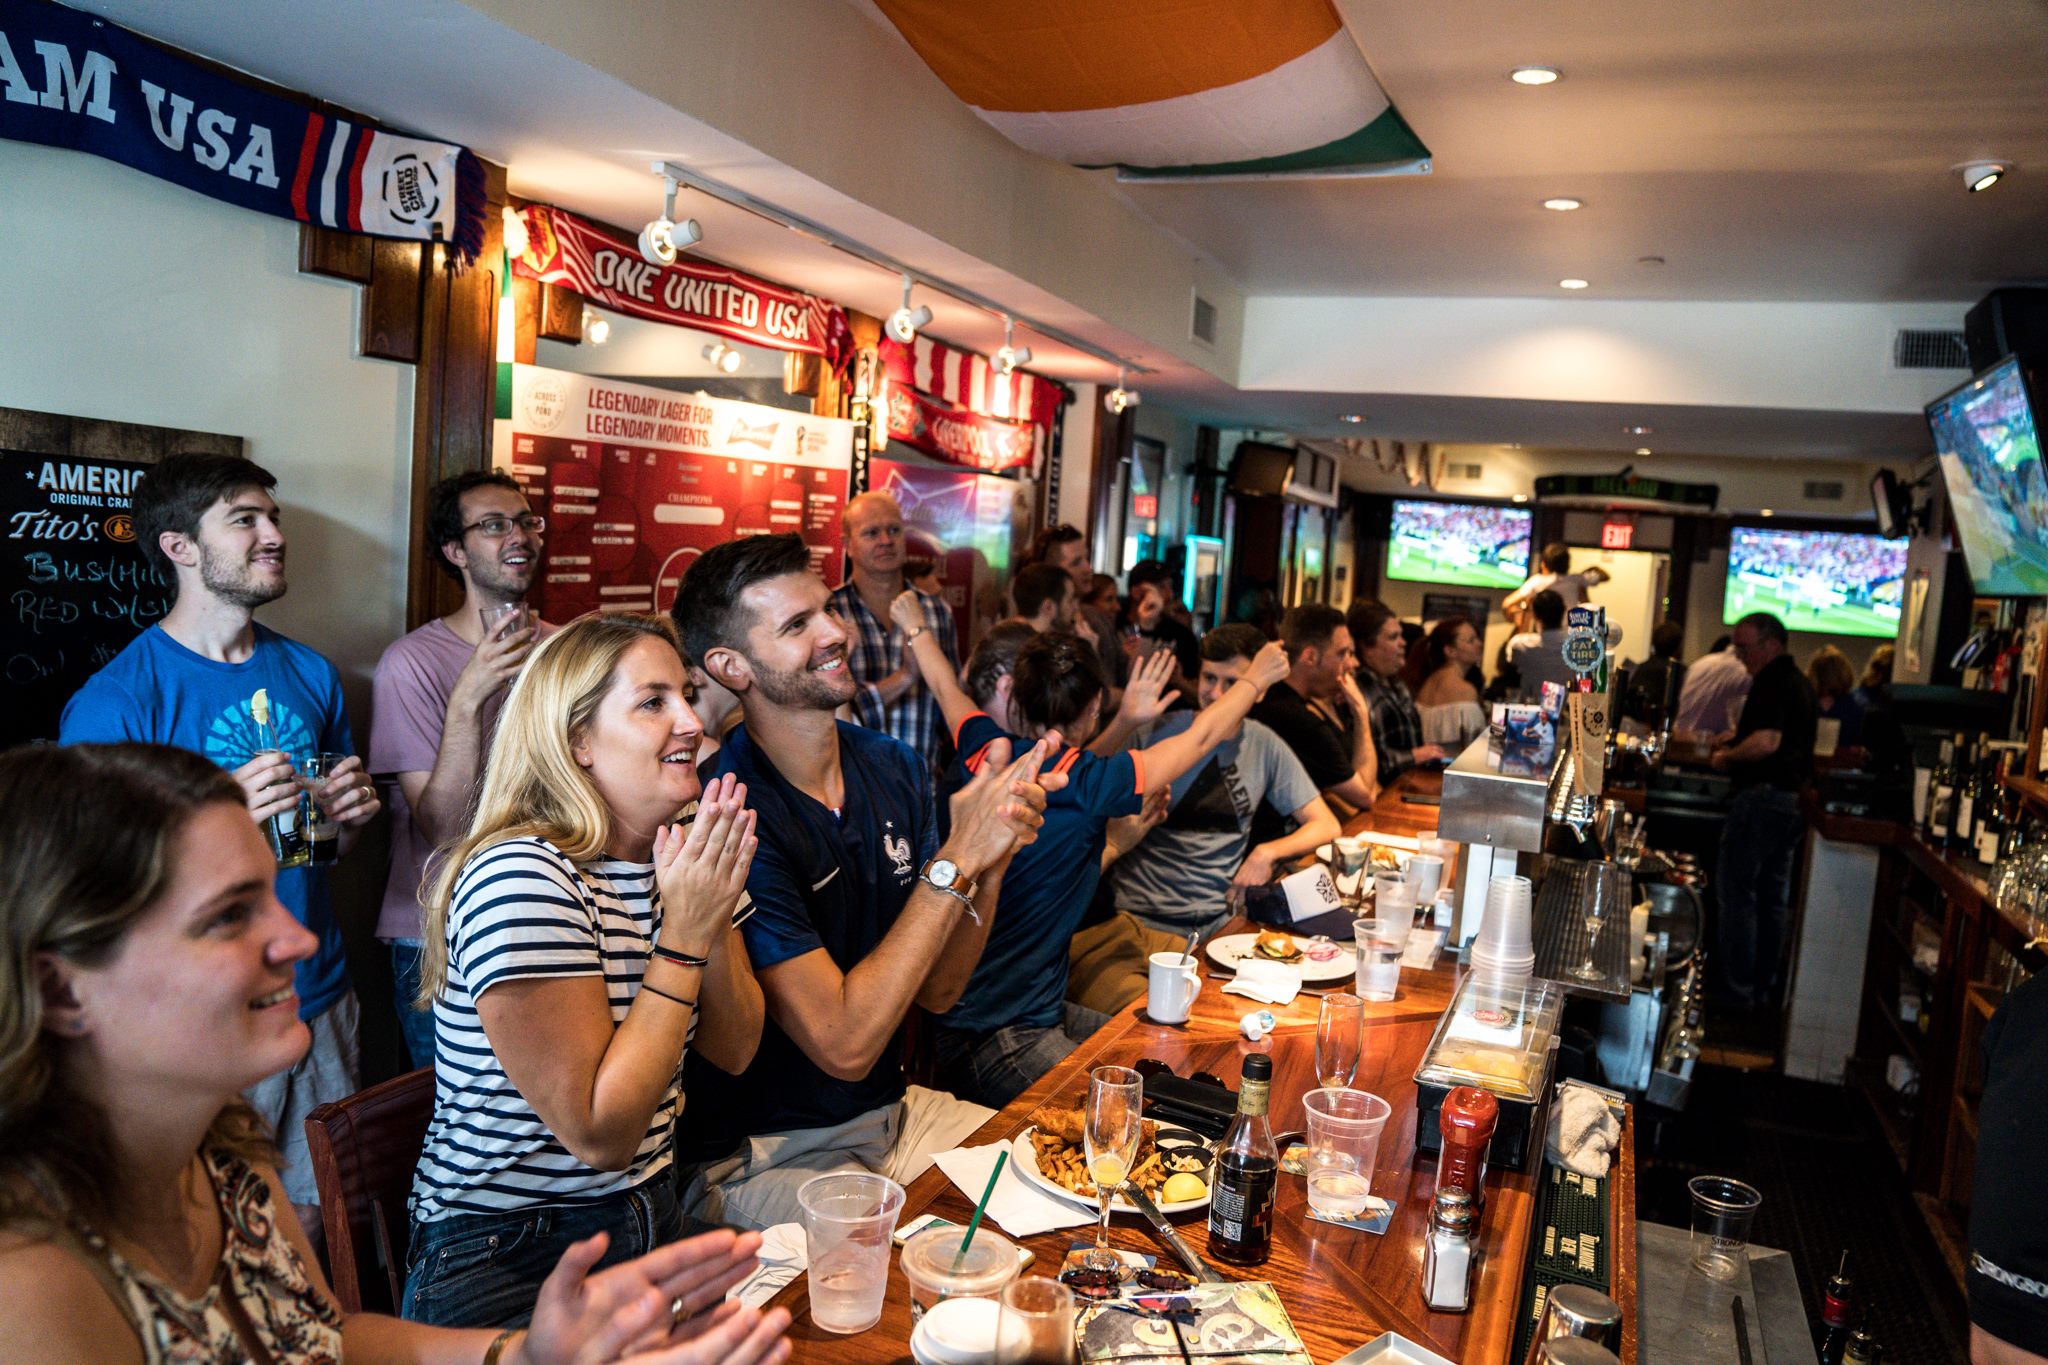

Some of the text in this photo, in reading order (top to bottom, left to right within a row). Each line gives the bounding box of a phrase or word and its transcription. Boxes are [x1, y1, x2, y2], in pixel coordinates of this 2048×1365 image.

[141, 79, 281, 190] USA
[396, 169, 412, 213] STREET
[404, 167, 421, 212] CHILD
[593, 249, 811, 342] ONE UNITED USA
[587, 388, 714, 426] LEGENDARY LAGER FOR
[586, 413, 657, 442] LEGENDARY
[656, 423, 712, 449] MOMENTS.
[50, 492, 104, 507] ORIGINAL
[667, 493, 713, 505] CHAMPIONS
[1602, 525, 1633, 549] EXIT
[10, 589, 80, 635] RED
[1570, 650, 1596, 659] TIRE
[1571, 641, 1593, 650] FAT
[1578, 1232, 1600, 1273] TULLAMORE
